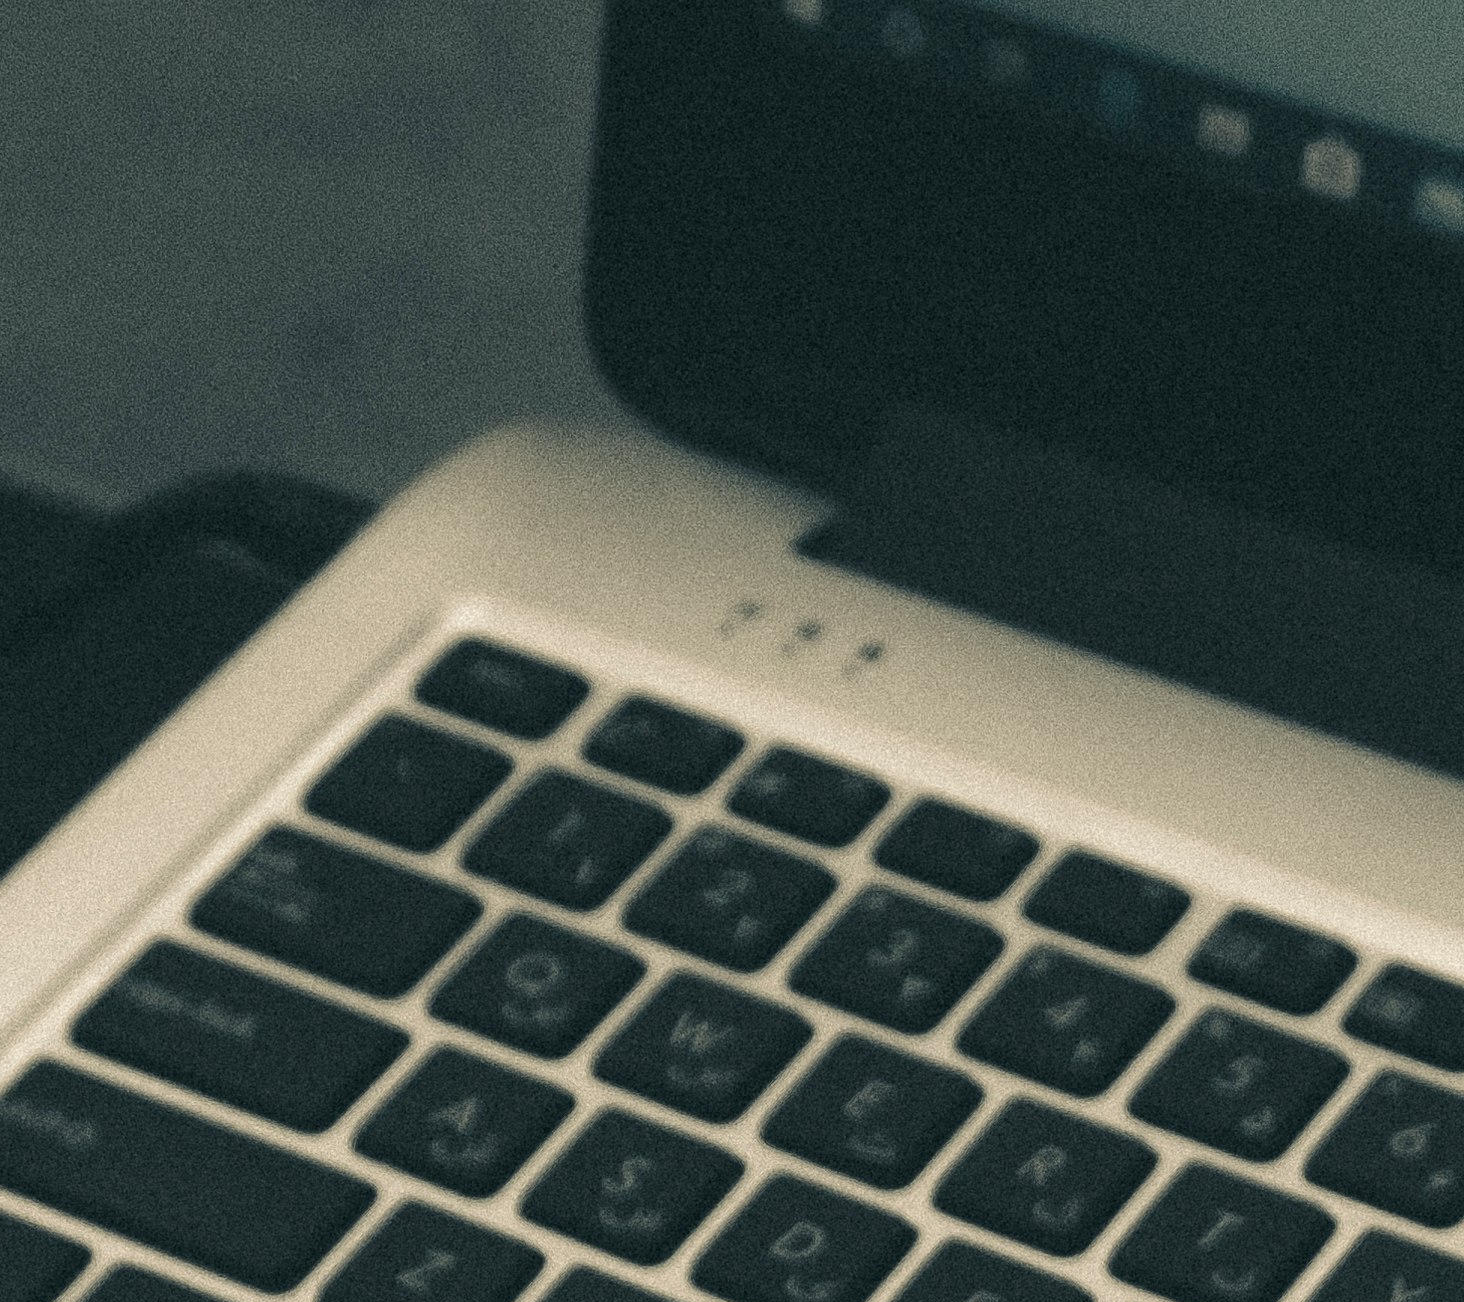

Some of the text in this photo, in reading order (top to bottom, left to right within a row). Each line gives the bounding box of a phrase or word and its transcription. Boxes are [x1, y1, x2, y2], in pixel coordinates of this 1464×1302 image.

[671, 1014, 723, 1052] W
[432, 1096, 482, 1134] A
[604, 1159, 649, 1192] S
[1020, 1147, 1064, 1184] R
[771, 1222, 824, 1259] D
[1200, 1212, 1242, 1245] T
[398, 1251, 454, 1288] Z
